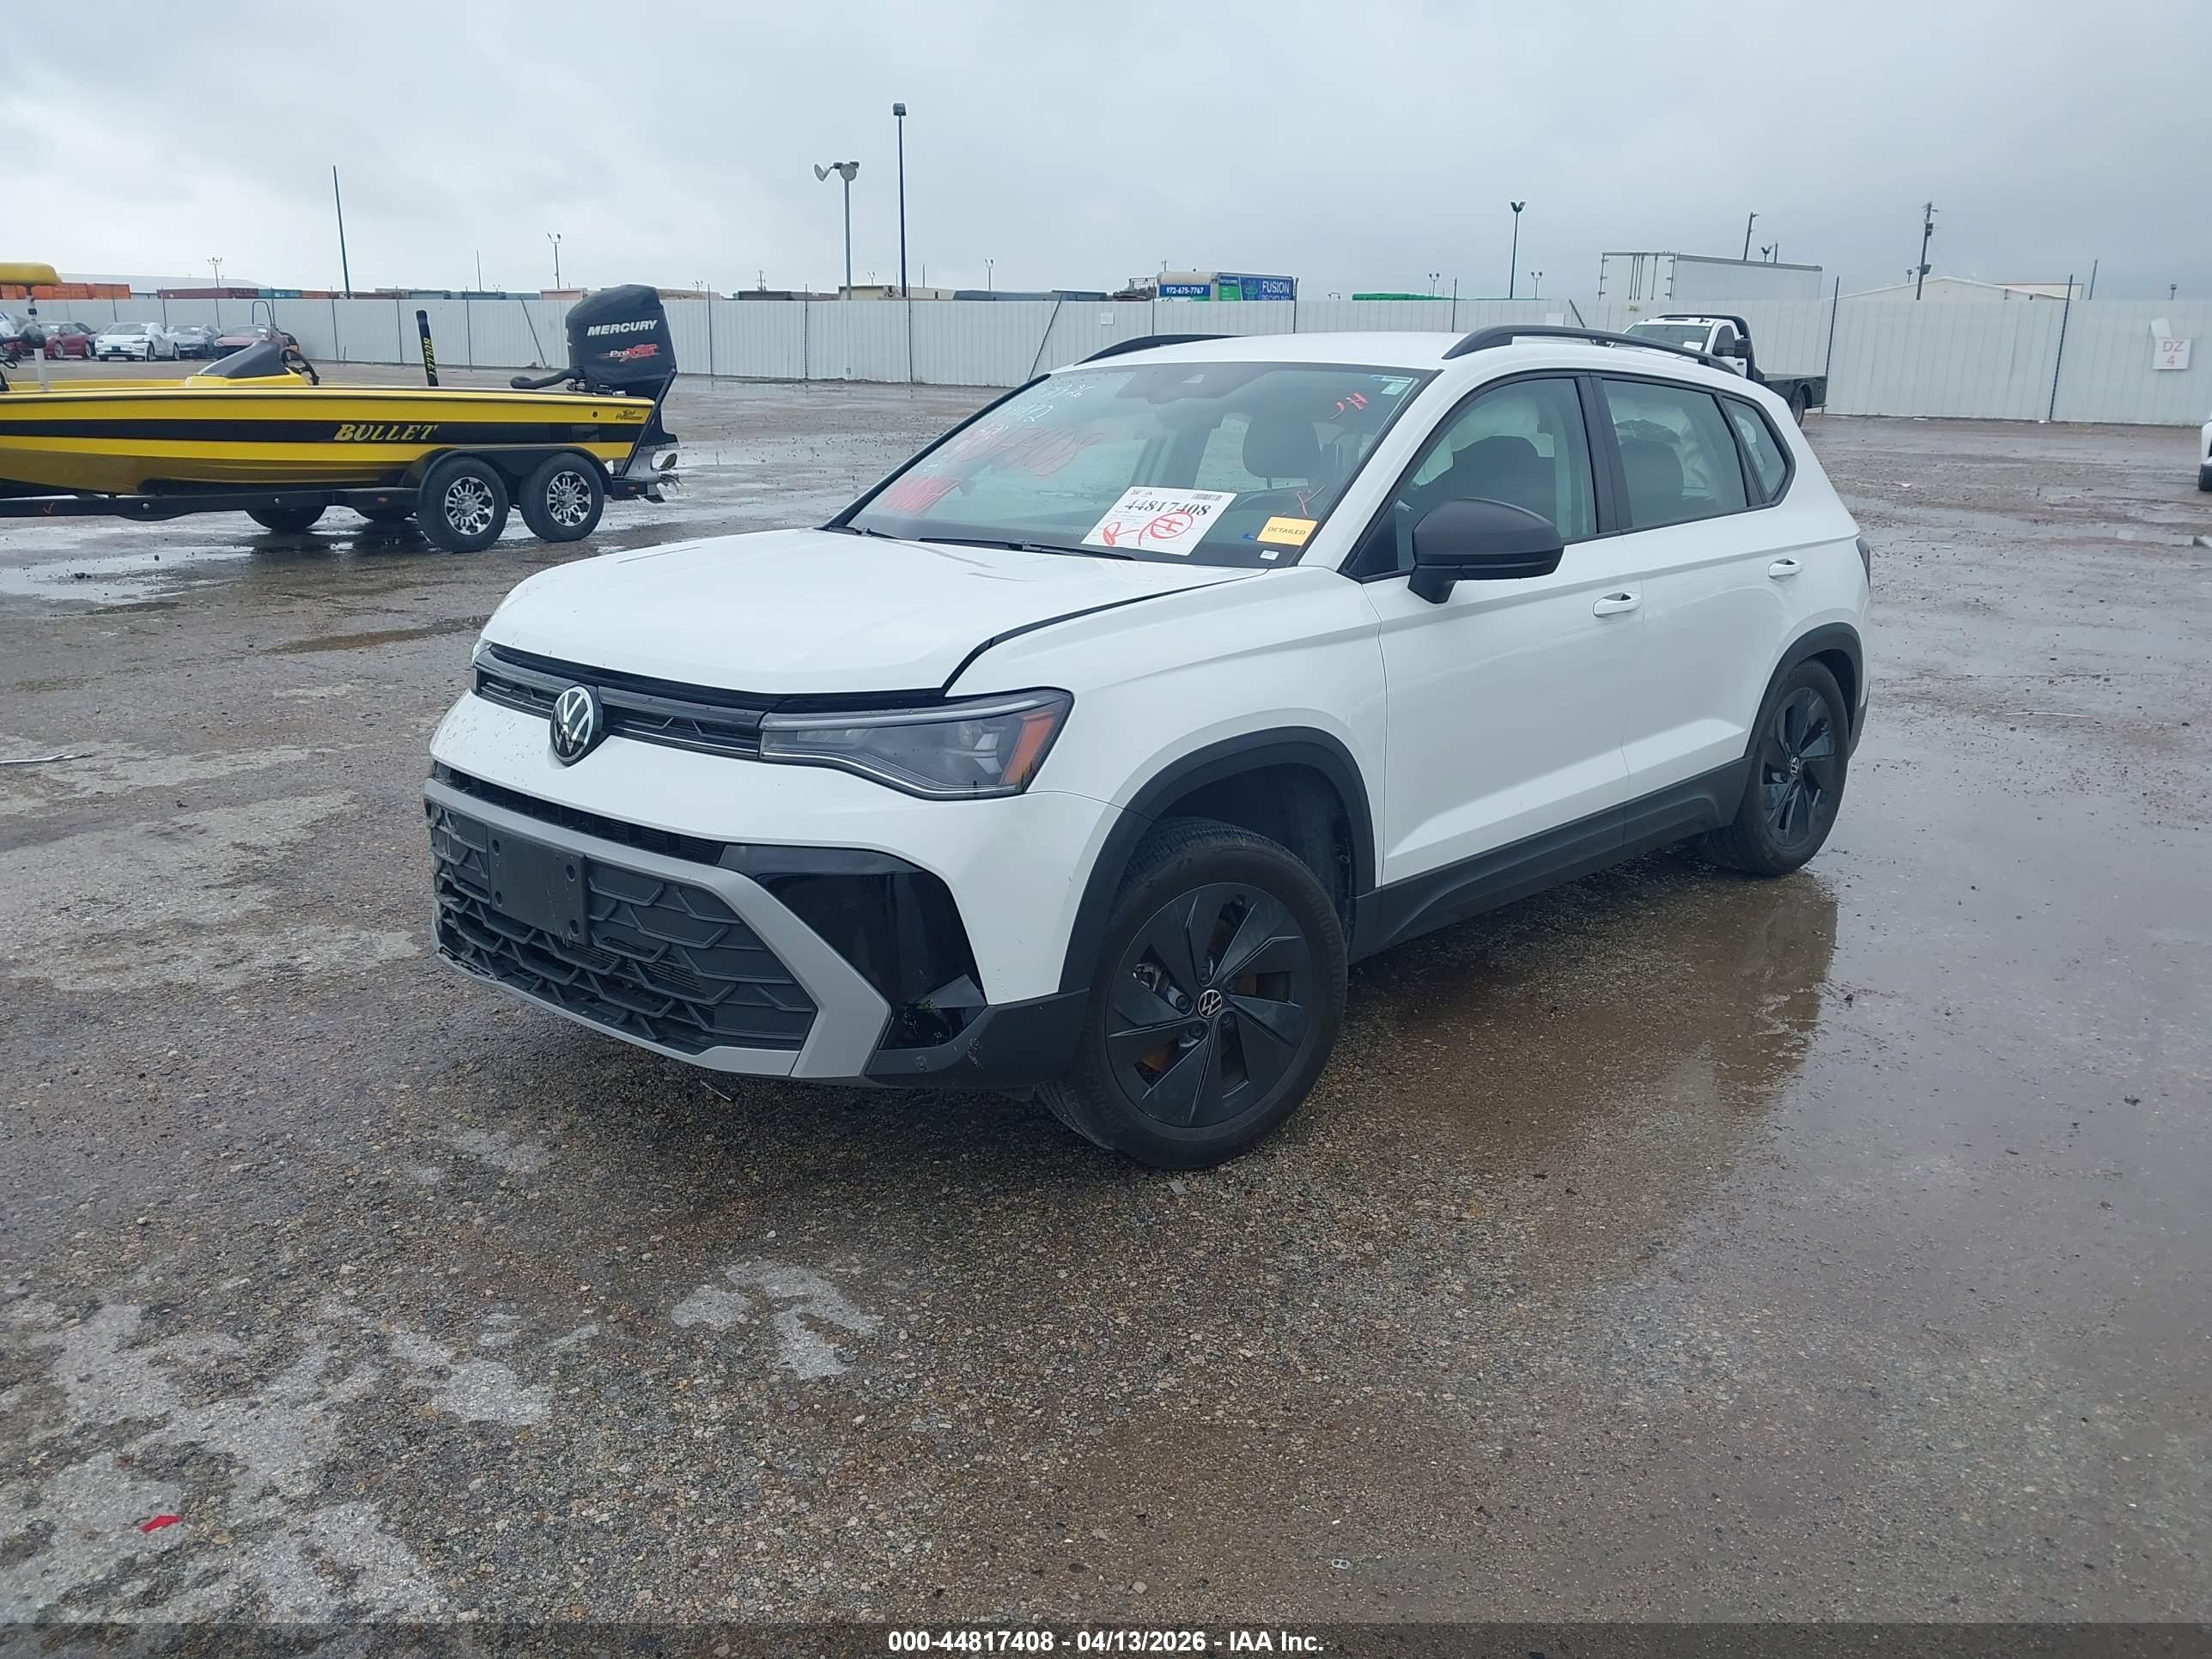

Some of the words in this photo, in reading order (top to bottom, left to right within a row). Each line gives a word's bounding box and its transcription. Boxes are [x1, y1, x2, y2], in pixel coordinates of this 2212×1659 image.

[1165, 286, 1204, 295] 972-675-7767
[1261, 280, 1290, 294] FUSION
[586, 319, 658, 337] MERCURY
[2163, 341, 2185, 352] DZ
[423, 337, 437, 378] BULLET
[2166, 356, 2175, 366] 4
[333, 423, 440, 441] BULLET
[1124, 500, 1212, 516] 44817408
[1267, 526, 1306, 536] DETAILED
